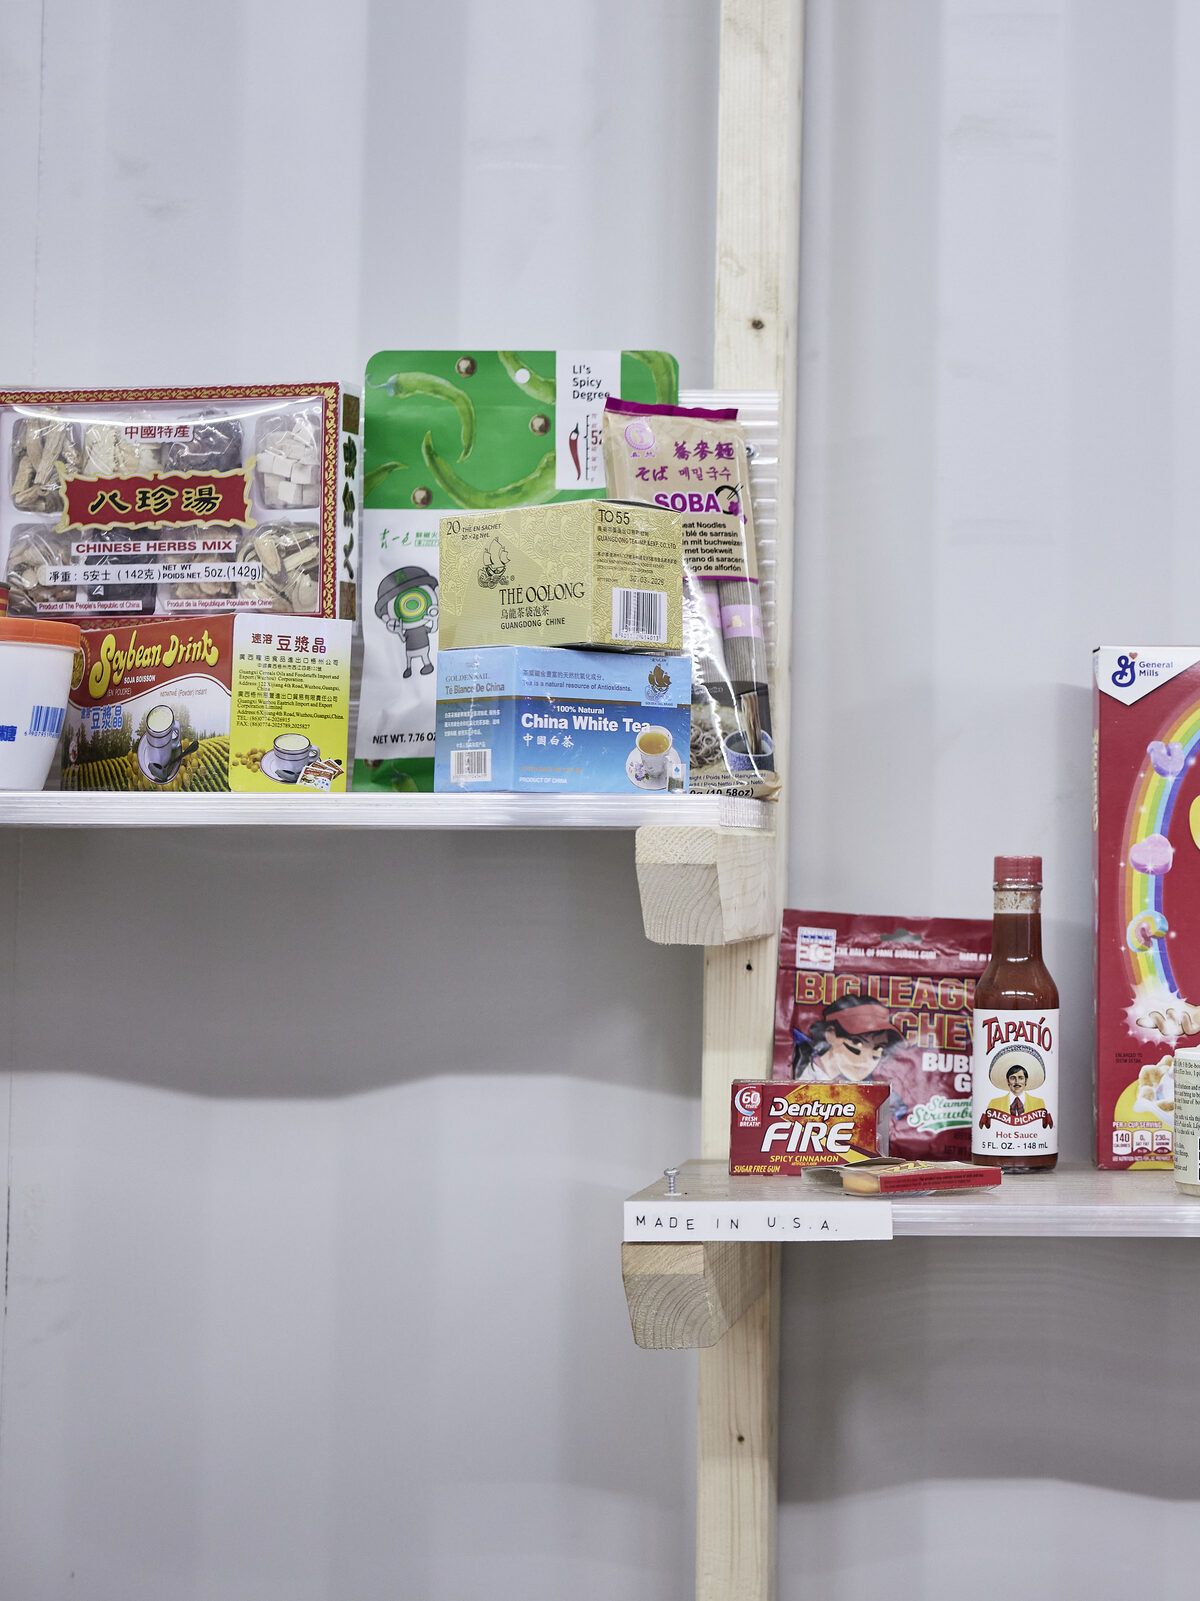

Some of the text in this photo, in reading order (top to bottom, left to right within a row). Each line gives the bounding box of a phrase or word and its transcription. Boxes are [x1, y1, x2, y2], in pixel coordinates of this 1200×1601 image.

[572, 377, 602, 388] Spicy
[572, 390, 610, 401] Degree
[636, 466, 668, 482] そば
[89, 484, 222, 514] 八珍湯
[655, 493, 722, 512] SOBA
[616, 511, 630, 525] 55
[697, 521, 727, 529] Noodles
[446, 520, 461, 535] 20
[481, 523, 502, 531] SACHET
[76, 541, 232, 554] CHINESE HERBS MIX
[525, 582, 586, 602] OOLONG
[501, 617, 566, 630] GUANGDONG CHINE
[89, 629, 219, 700] Soybean Drink
[124, 675, 156, 684] SOJA BOISSON
[476, 683, 505, 692] De China
[597, 684, 632, 692] Antioxidants.
[578, 706, 604, 714] Natural
[521, 713, 650, 733] China White Tea
[372, 733, 425, 744] NET WT. 7.76
[795, 971, 975, 1011] BIG LEAG
[892, 1011, 974, 1050] CHE
[922, 1052, 973, 1073] BUB
[742, 1091, 760, 1105] 60
[769, 1097, 855, 1120] Dentyne
[986, 1109, 1047, 1125] SALSA PICANTE
[761, 1121, 855, 1152] FIRE
[996, 1131, 1038, 1139] Hot Sauce
[1115, 1133, 1129, 1143] 140
[987, 1142, 998, 1150] FL.
[1001, 1142, 1015, 1150] OZ.
[733, 1165, 780, 1173] SUGAR FREE GUM
[636, 1216, 838, 1232] MADE IN U.S.A.
